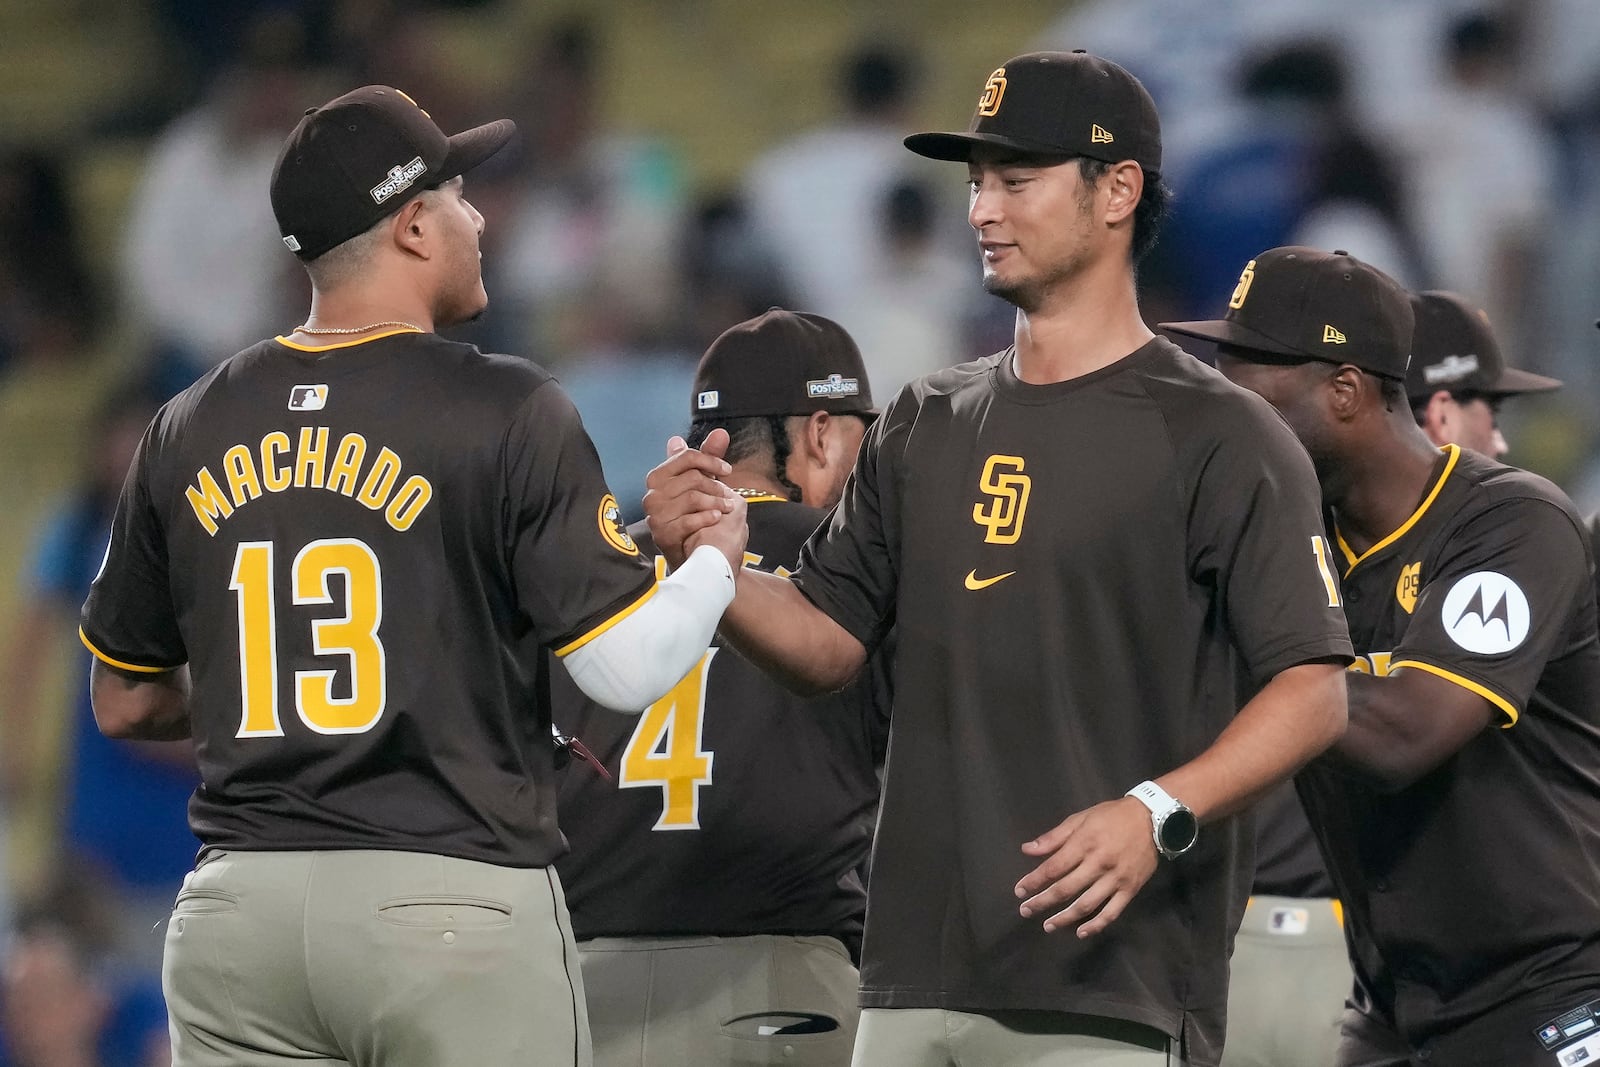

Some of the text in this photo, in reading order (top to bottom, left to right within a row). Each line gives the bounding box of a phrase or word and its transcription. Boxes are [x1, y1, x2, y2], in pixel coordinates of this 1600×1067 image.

[374, 160, 424, 201] POSTSEASON
[810, 382, 857, 395] POSTSEASON
[185, 426, 433, 537] MACHADO
[972, 454, 1032, 545] SD
[228, 537, 386, 739] 13
[618, 646, 715, 832] 4
